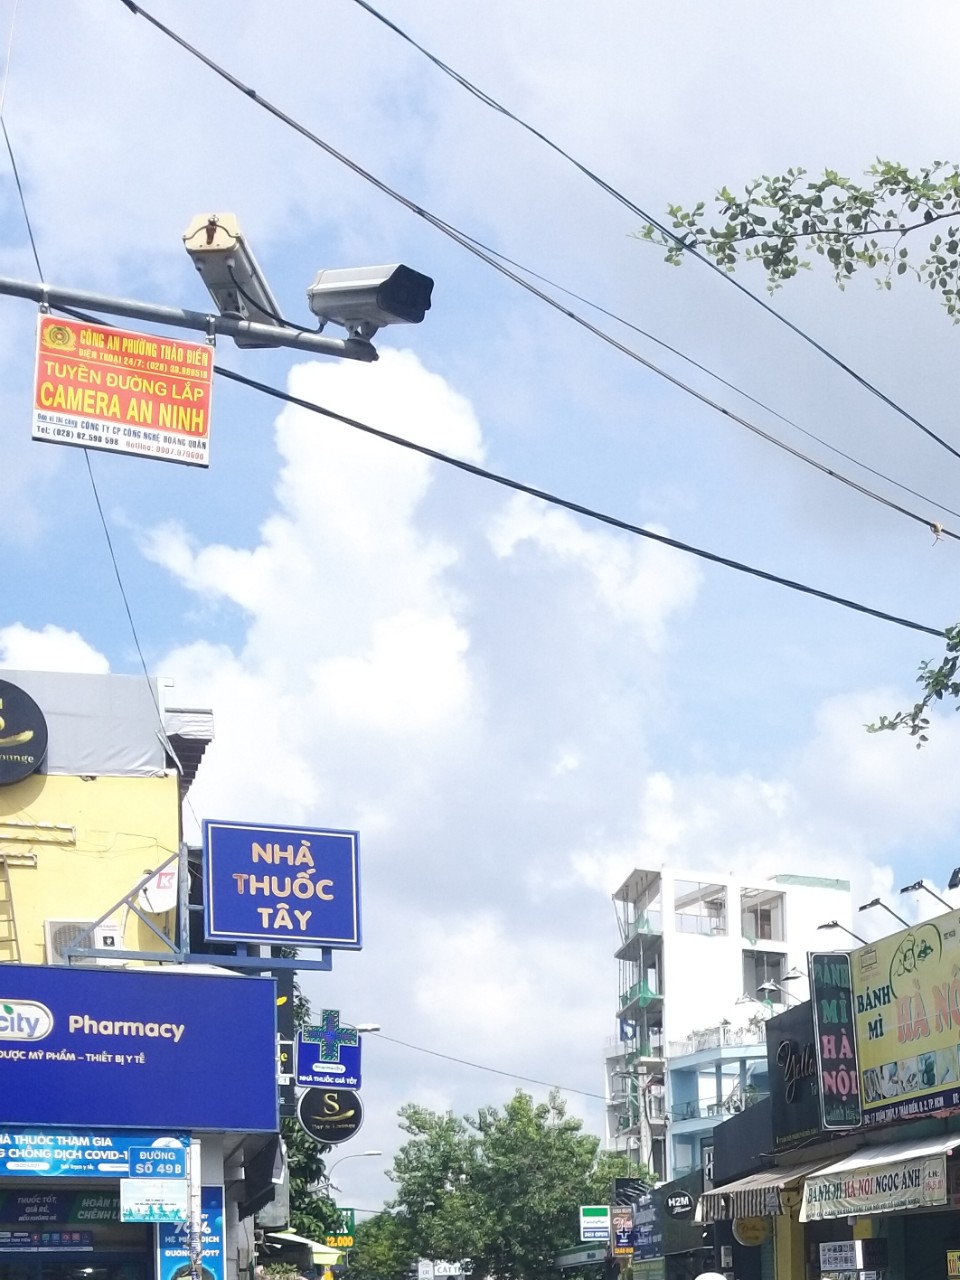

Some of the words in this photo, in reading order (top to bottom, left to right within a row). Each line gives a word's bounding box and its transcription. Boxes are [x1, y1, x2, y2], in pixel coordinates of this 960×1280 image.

[80, 329, 105, 348] CÔNG
[107, 336, 120, 351] AN
[122, 337, 157, 357] PHƯỜNG
[106, 373, 167, 397] ĐƯỜNG
[172, 382, 204, 402] LẮP
[40, 381, 121, 419] CAMERA
[126, 398, 152, 424] AN
[159, 403, 204, 433] NINH
[102, 425, 110, 434] TY
[0, 752, 34, 763] ounge
[252, 840, 314, 867] NHÀ
[232, 868, 334, 900] THUỐC
[257, 903, 312, 930] TÂY
[815, 957, 849, 988] BÁNH
[821, 992, 848, 1023] MÌ
[857, 985, 891, 1014] BÁNH
[896, 978, 930, 1044] HÀ
[69, 1015, 185, 1043] Pharmacy
[868, 1013, 884, 1040] MÌ
[28, 1049, 44, 1060] MỸ
[46, 1048, 76, 1061] PHẨM
[86, 1051, 113, 1063] THIẾT
[115, 1054, 125, 1066] BỊ
[126, 1055, 133, 1063] Y
[134, 1052, 146, 1064] TẾ
[822, 1028, 853, 1059] HÀ
[823, 1064, 858, 1101] NỘI
[323, 1093, 340, 1114] S
[13, 1132, 54, 1145] THUỐC
[56, 1136, 90, 1146] THAM
[92, 1137, 112, 1146] GIA
[54, 1149, 82, 1161] DỊCH
[85, 1150, 128, 1160] COVID-1
[135, 1161, 153, 1173] SỐ
[139, 1150, 175, 1160] ĐƯỜNG
[844, 1175, 856, 1198] HÀ
[859, 1173, 874, 1200] NỘI
[875, 1172, 899, 1197] NGỌC
[901, 1165, 920, 1190] ÁNH
[17, 1194, 42, 1204] THUỐC
[82, 1197, 108, 1208] HOÀN
[668, 1196, 690, 1207] H2M
[77, 1207, 111, 1220] CHÊNH
